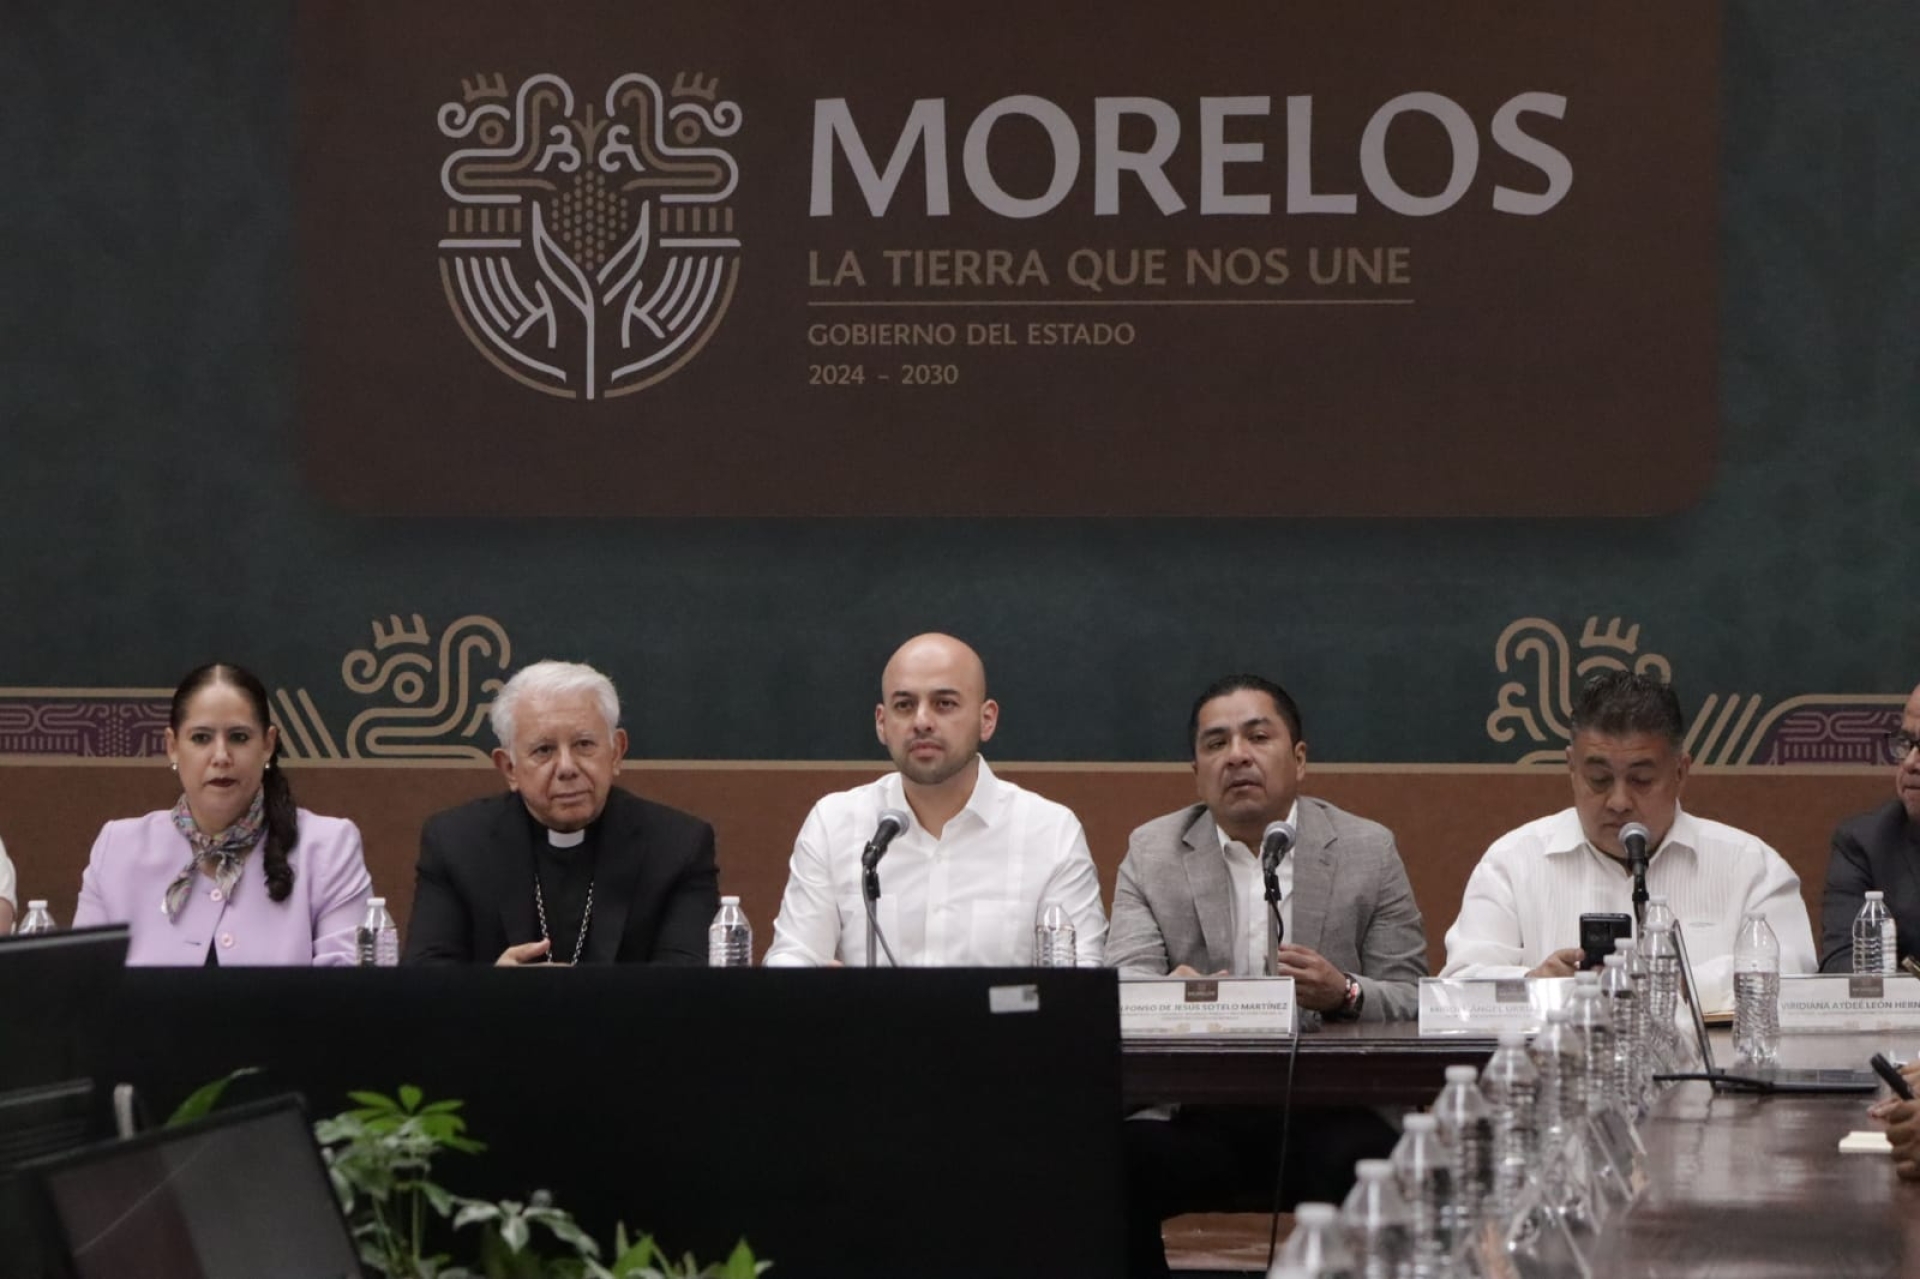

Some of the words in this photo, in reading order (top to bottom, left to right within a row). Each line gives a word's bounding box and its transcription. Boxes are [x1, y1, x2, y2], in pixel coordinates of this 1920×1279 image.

[809, 91, 1573, 219] MORELOS
[809, 251, 865, 286] LA
[883, 250, 1049, 286] TIERRA
[1067, 249, 1165, 291] QUE
[1187, 249, 1289, 284] NOS
[1309, 248, 1411, 285] UNE
[808, 323, 956, 347] GOBIERNO
[967, 323, 1018, 346] DEL
[1027, 322, 1137, 346] ESTADO
[808, 364, 866, 386] 2024
[901, 363, 960, 386] 2030
